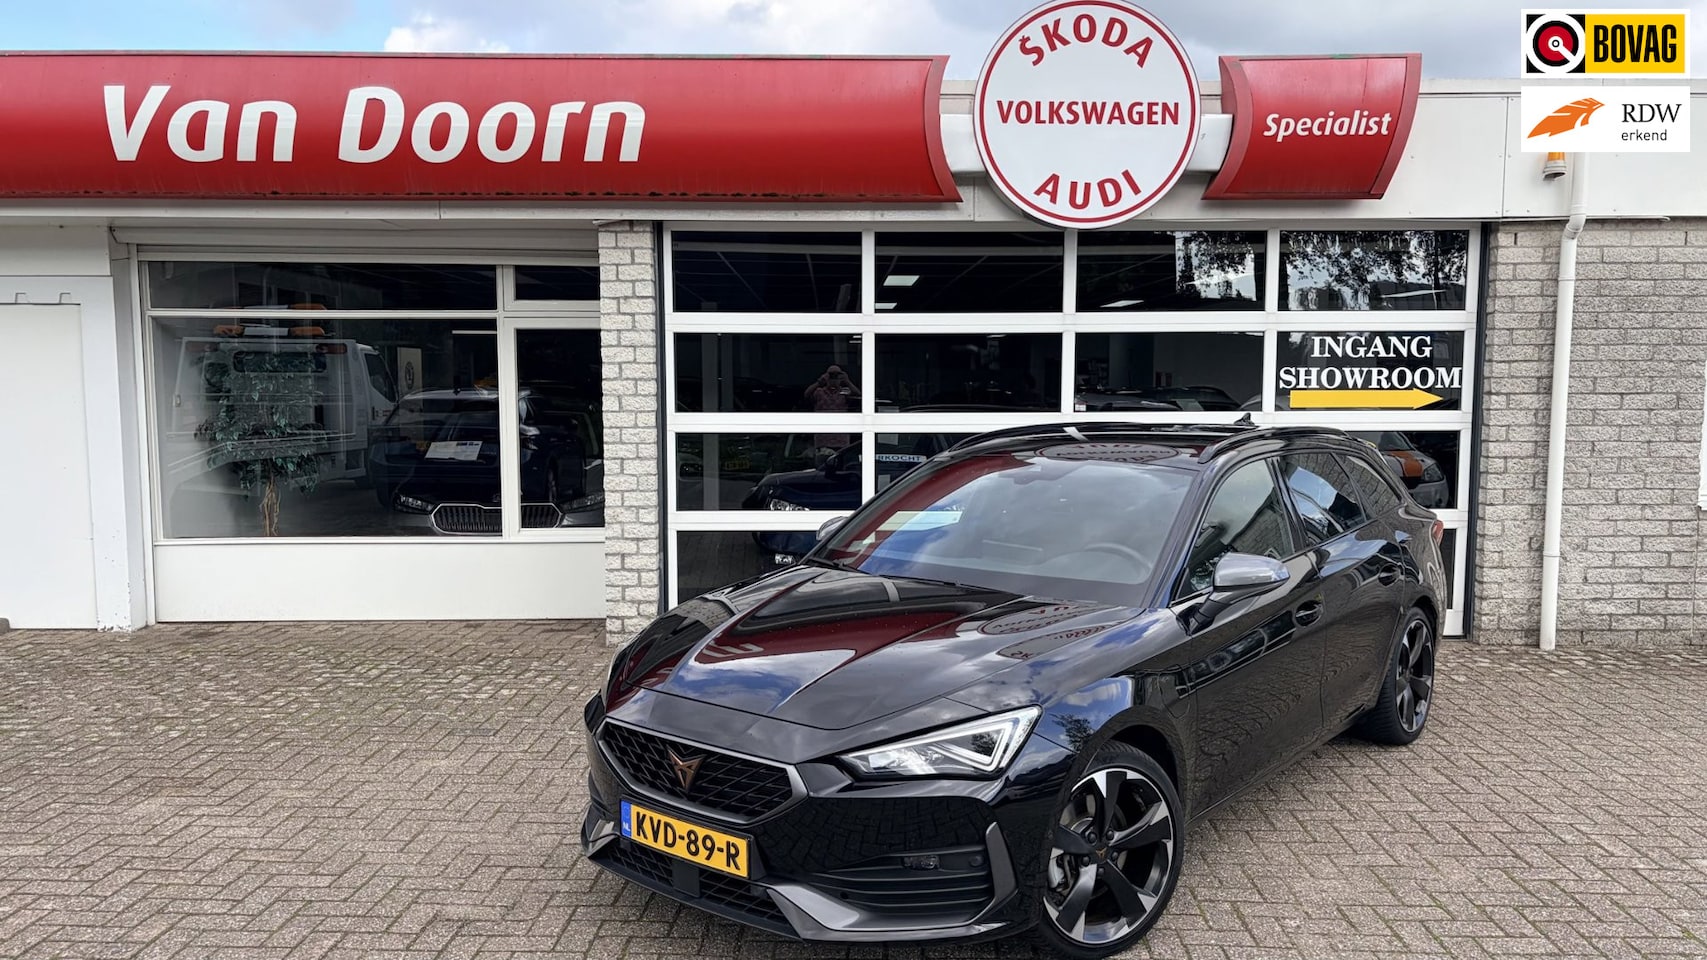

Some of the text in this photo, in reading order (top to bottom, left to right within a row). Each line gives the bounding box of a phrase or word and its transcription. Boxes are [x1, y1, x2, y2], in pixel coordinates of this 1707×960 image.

[1018, 13, 1153, 67] ŠKODA
[103, 84, 646, 164] Van Doorn
[997, 100, 1180, 125] VOLKSWAGEN
[1263, 110, 1392, 142] Specialist
[1033, 169, 1141, 209] AUDI
[1311, 335, 1432, 358] INGANG
[1279, 366, 1462, 389] SHOWROOM
[636, 811, 741, 870] KVD-89-R
